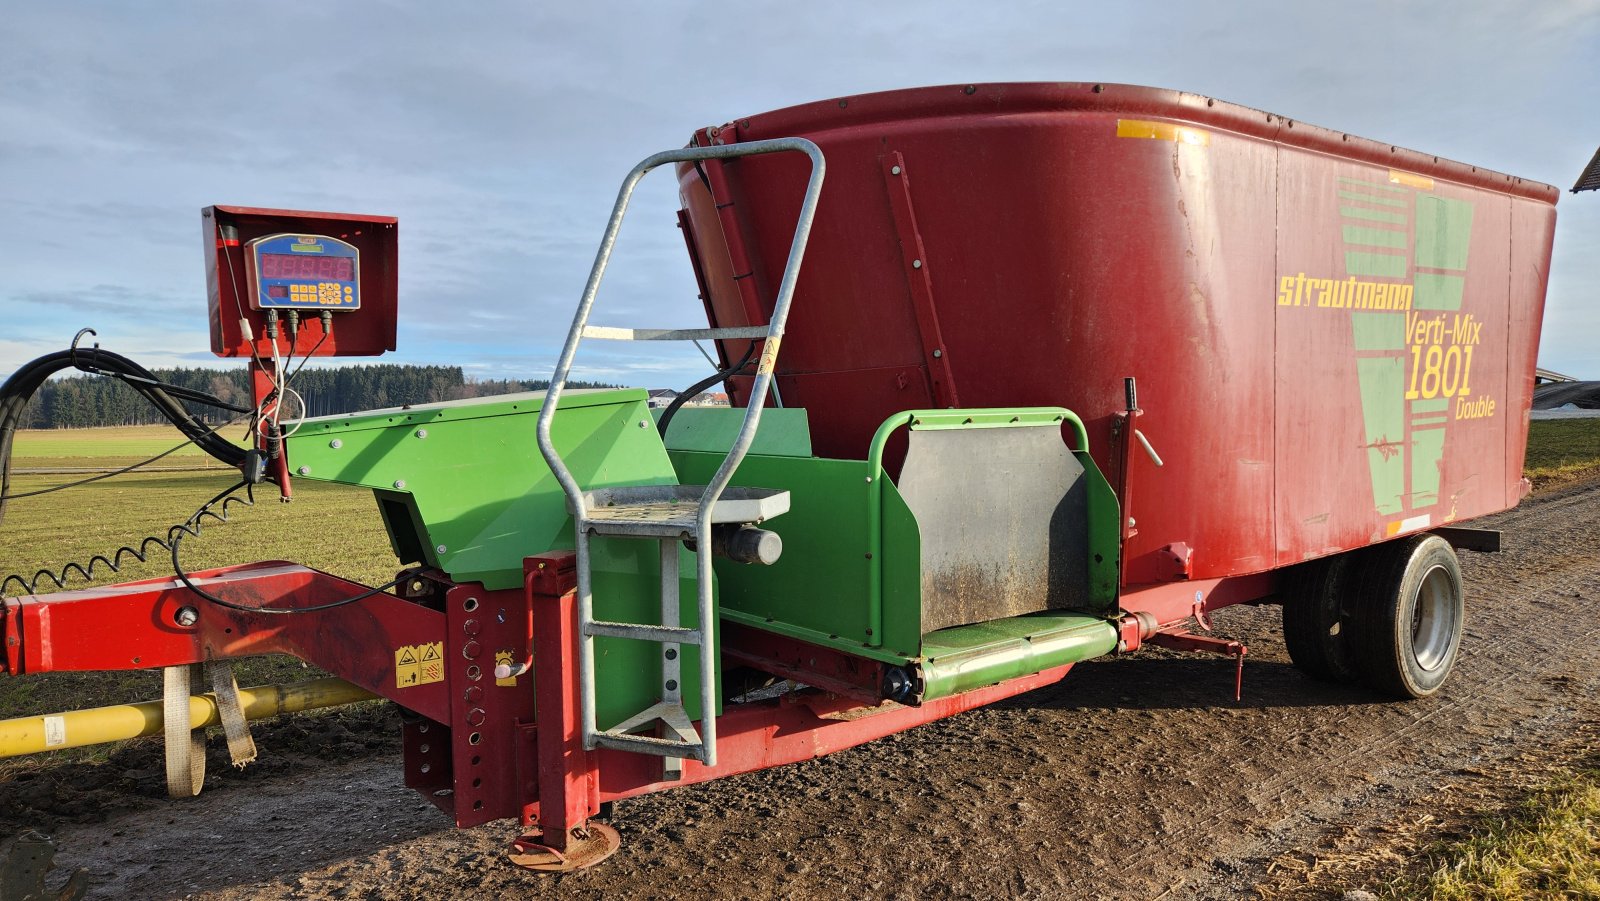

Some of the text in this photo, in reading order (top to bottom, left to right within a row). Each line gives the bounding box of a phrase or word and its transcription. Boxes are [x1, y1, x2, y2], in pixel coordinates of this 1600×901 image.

[1278, 272, 1413, 310] strautmann
[1405, 310, 1482, 345] Verti-Mix
[1405, 345, 1473, 400] 1801
[1455, 395, 1495, 420] Double
